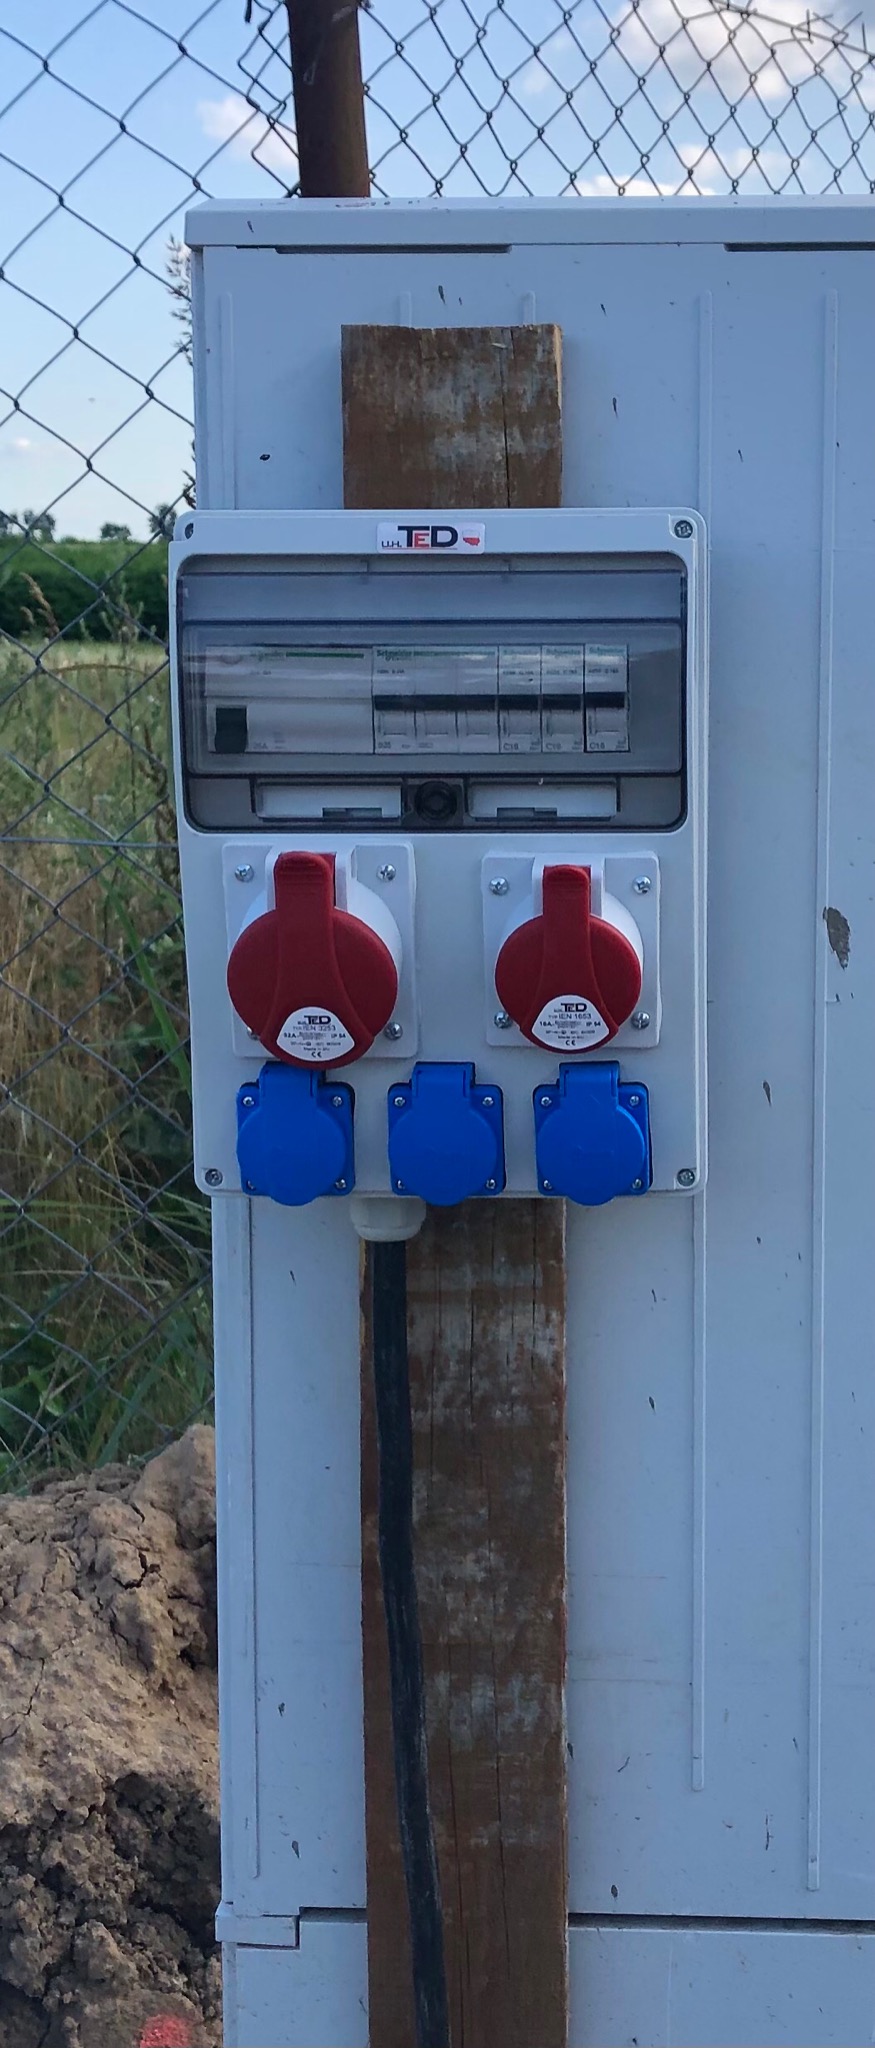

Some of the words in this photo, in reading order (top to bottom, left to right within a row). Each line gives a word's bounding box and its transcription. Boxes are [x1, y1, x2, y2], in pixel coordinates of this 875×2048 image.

[397, 525, 458, 548] TED
[560, 1002, 587, 1013] TED
[303, 1015, 332, 1025] TED
